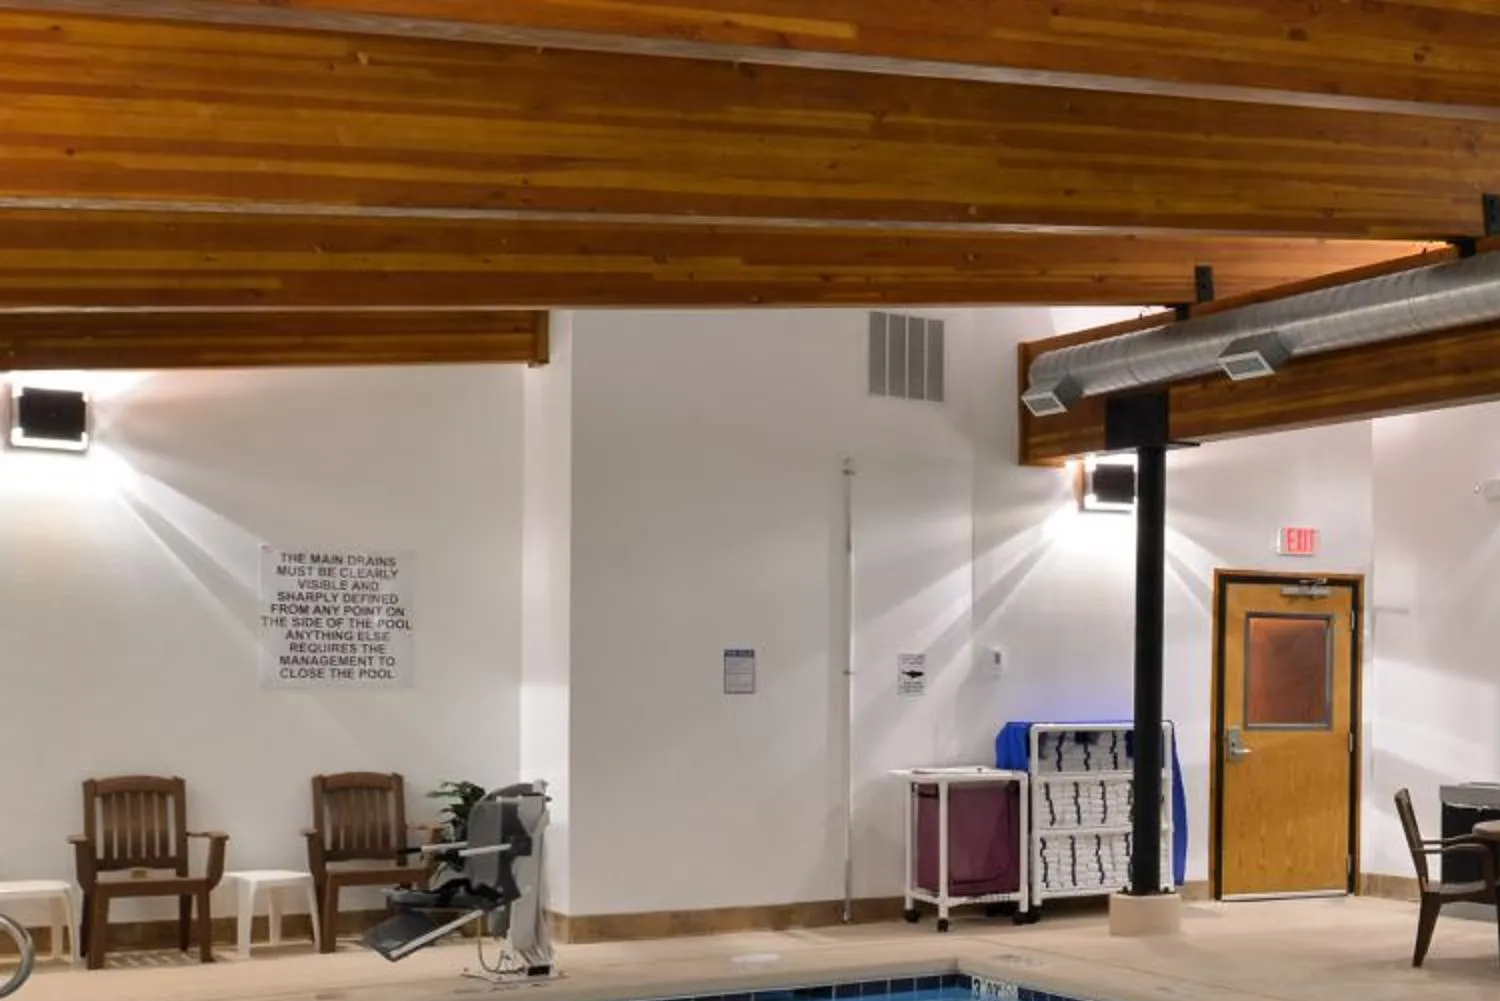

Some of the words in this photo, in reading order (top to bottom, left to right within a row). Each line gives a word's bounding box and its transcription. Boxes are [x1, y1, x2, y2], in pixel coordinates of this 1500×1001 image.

[1287, 528, 1317, 552] EXIT
[281, 553, 306, 563] THE
[310, 554, 343, 564] MAIN
[347, 555, 398, 566] DRAINS
[276, 566, 313, 576] MUST
[318, 567, 336, 577] BE
[339, 567, 399, 579] CLEARLY
[297, 579, 348, 590] VISIBLE
[351, 581, 380, 591] AND
[277, 591, 338, 602] SHARPLY
[343, 593, 399, 605] DEFINED
[270, 604, 308, 614] FROM
[312, 605, 340, 616] ANY
[344, 606, 382, 616] POINT
[386, 607, 405, 617] ON
[260, 616, 287, 627] THE
[292, 617, 324, 628] SIDE
[326, 617, 344, 628] OF
[350, 618, 372, 629] THE
[377, 619, 412, 630] POOL
[285, 630, 353, 641] ANYTHING
[357, 631, 391, 642] ELSE
[289, 642, 356, 653] REQUIRES
[362, 643, 386, 654] THE
[279, 655, 374, 667] MANAGEMENT
[379, 656, 395, 666] TO
[279, 668, 325, 679] CLOSE
[330, 668, 354, 679] THE
[358, 669, 394, 679] POOL
